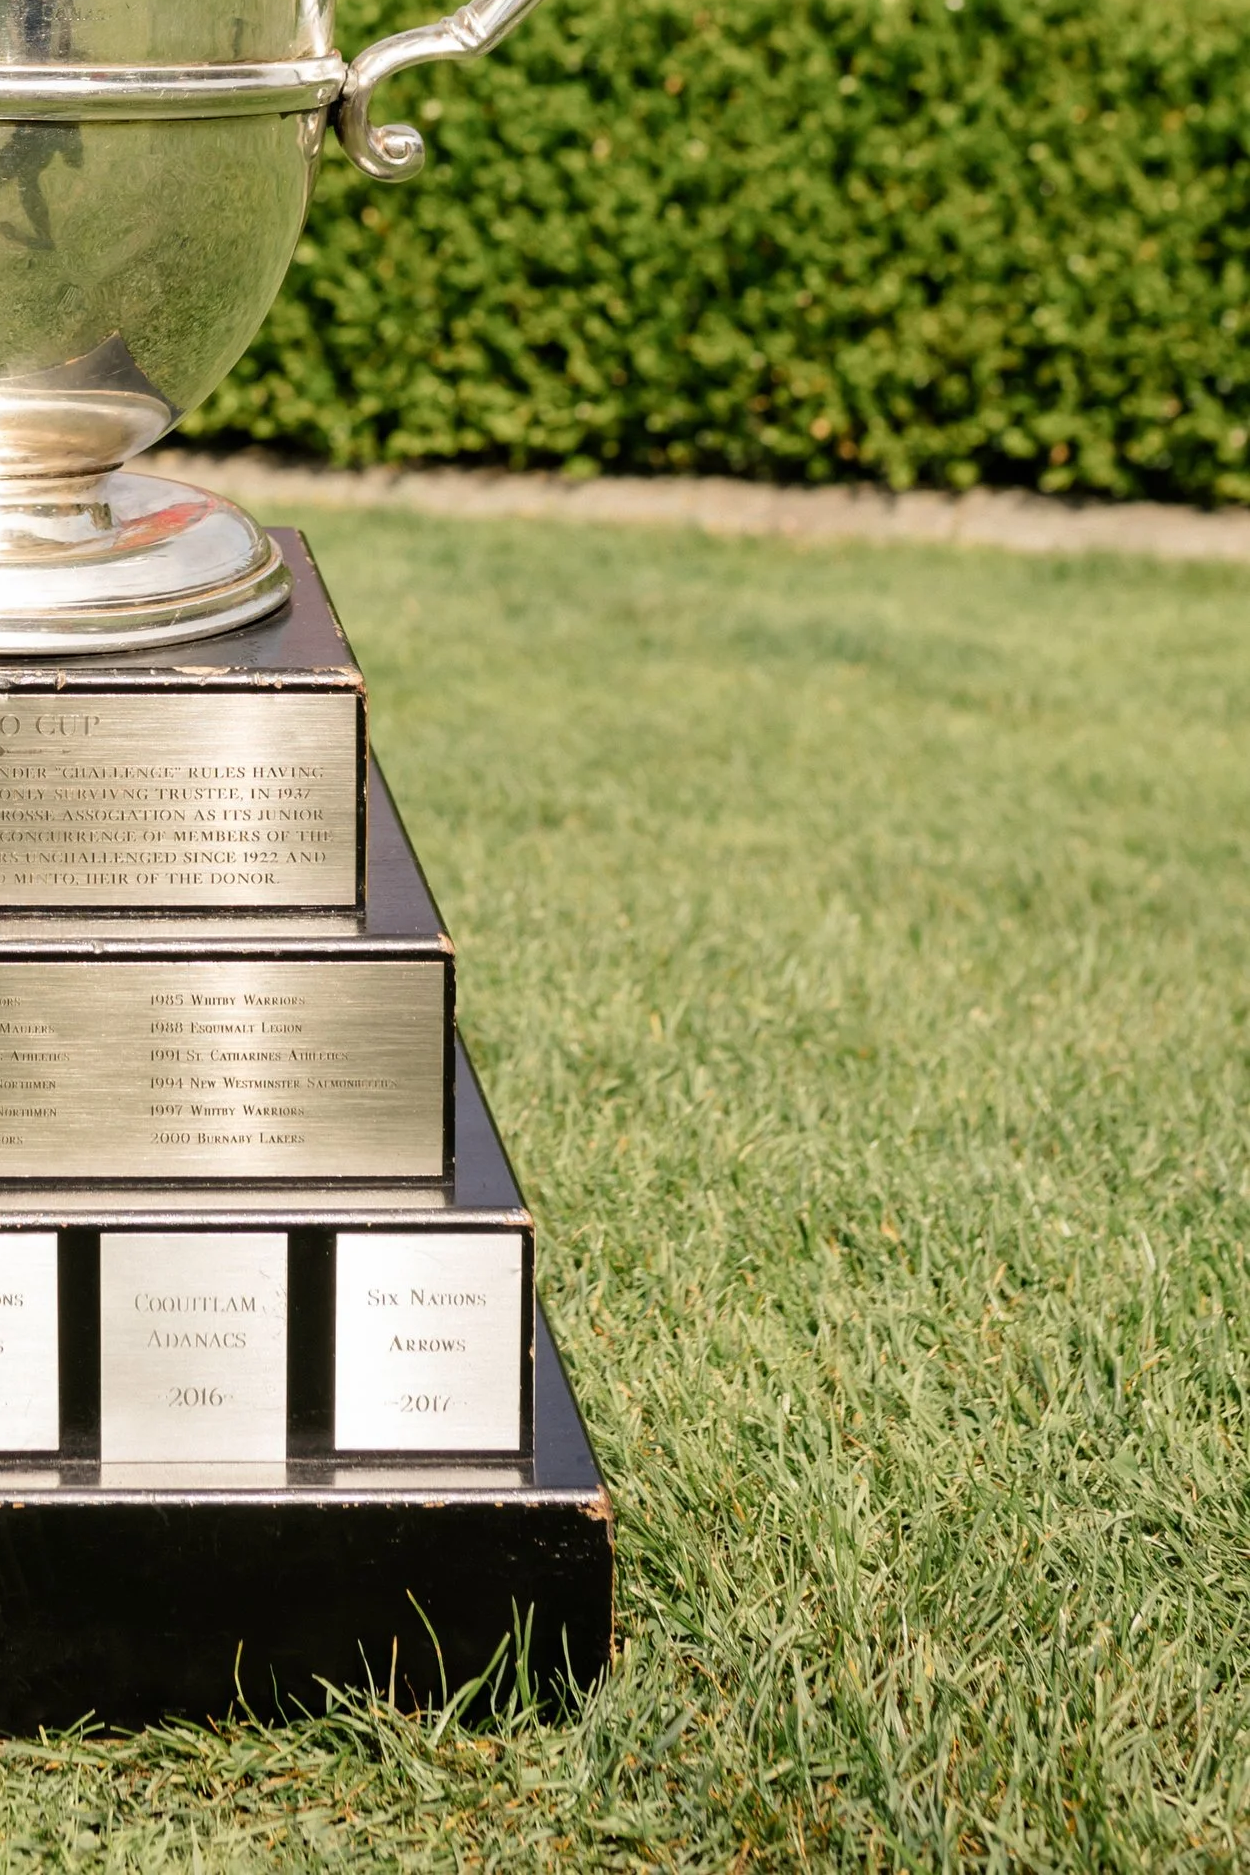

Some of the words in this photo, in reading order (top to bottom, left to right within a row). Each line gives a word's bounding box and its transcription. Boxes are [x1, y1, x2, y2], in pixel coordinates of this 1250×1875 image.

[36, 714, 100, 737] CUP
[189, 766, 245, 780] RULES
[253, 766, 324, 780] HAVING
[0, 788, 46, 801] ONLY
[155, 788, 244, 801] TRUSTEE,
[251, 788, 270, 801] IN
[277, 788, 311, 801] 1937
[62, 810, 186, 822] ASSOCIATION
[194, 810, 216, 822] AS
[223, 810, 250, 822] ITS
[258, 810, 324, 822] JUNIOR
[0, 830, 136, 843] CONCURRENCE
[143, 830, 166, 843] OF
[174, 830, 260, 843] MEMBERS
[267, 830, 291, 843] OF
[296, 830, 334, 843] THE
[26, 852, 177, 864] UNCHALLENGED
[183, 852, 237, 864] SINCE
[244, 852, 278, 864] 1922
[286, 852, 326, 864] AND
[86, 873, 129, 885] HEIR
[136, 873, 159, 885] OF
[168, 873, 203, 885] THE
[211, 873, 280, 885] DONOR.
[150, 994, 183, 1005] 1985
[150, 1021, 183, 1033] 1988
[150, 1049, 180, 1061] 1991
[150, 1077, 183, 1089] 1994
[150, 1104, 183, 1116] 1997
[150, 1132, 190, 1144] 2000
